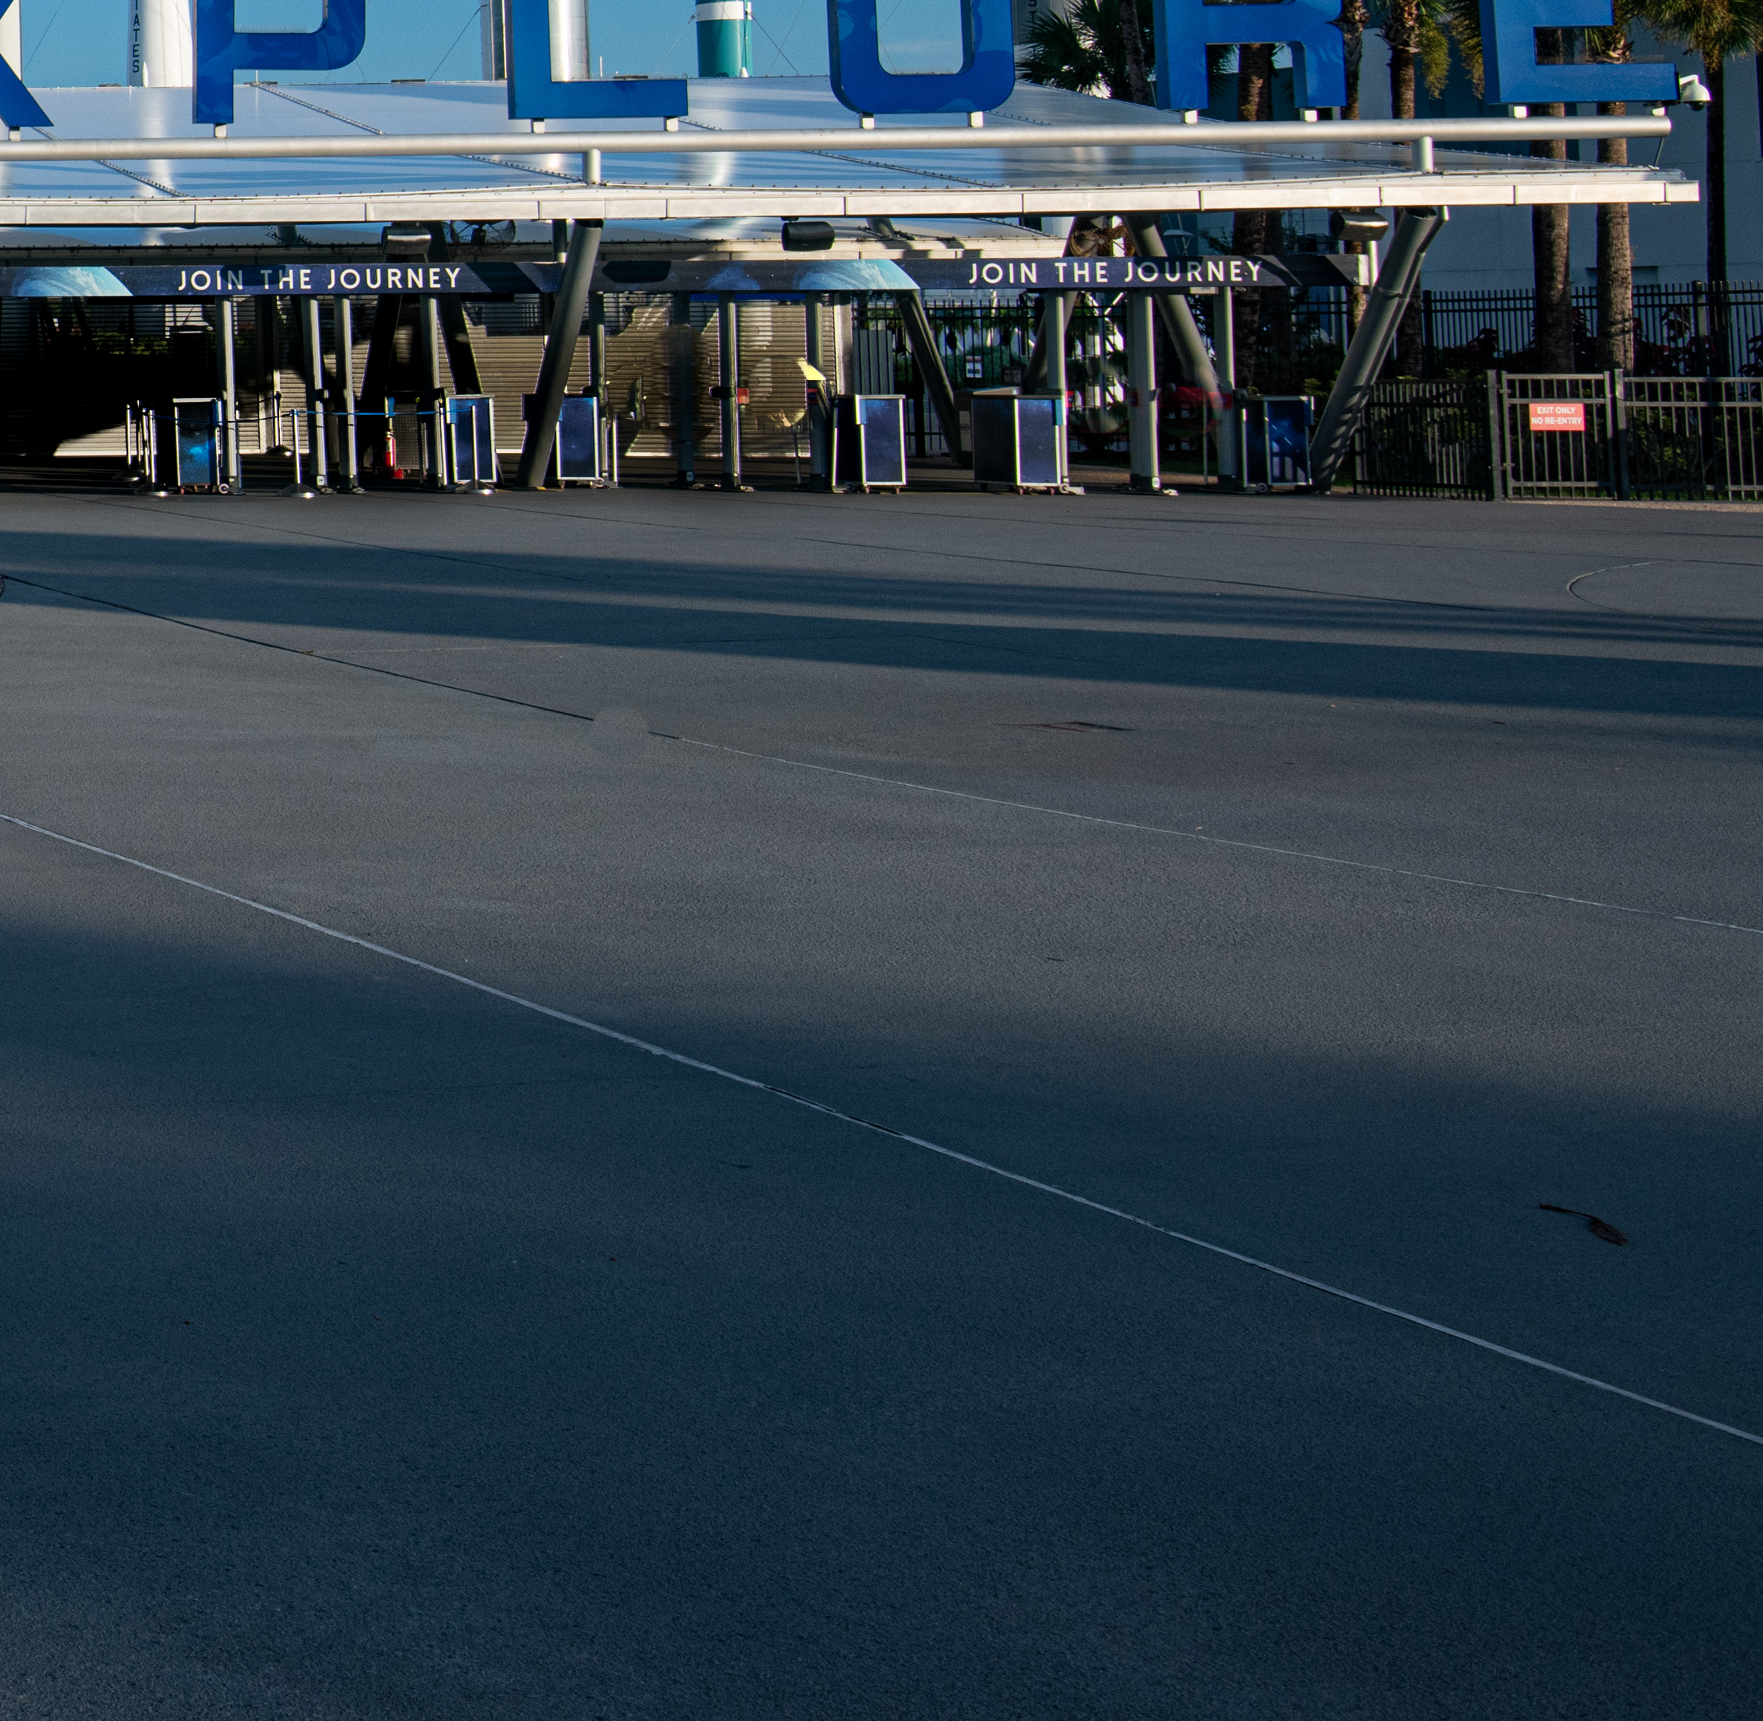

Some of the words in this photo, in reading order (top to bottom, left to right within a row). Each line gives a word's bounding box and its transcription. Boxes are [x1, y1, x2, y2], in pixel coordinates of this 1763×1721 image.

[178, 269, 243, 291] JOIN
[261, 269, 311, 290] THE
[327, 267, 461, 290] JOURNEY
[969, 262, 1037, 284] JOIN
[1054, 262, 1108, 283] THE
[1124, 260, 1262, 283] JOURNEY
[1536, 406, 1554, 414] EXIT
[1555, 406, 1576, 414] ONLY
[1531, 417, 1543, 425] NO
[1544, 416, 1582, 425] RE-ENTRY
